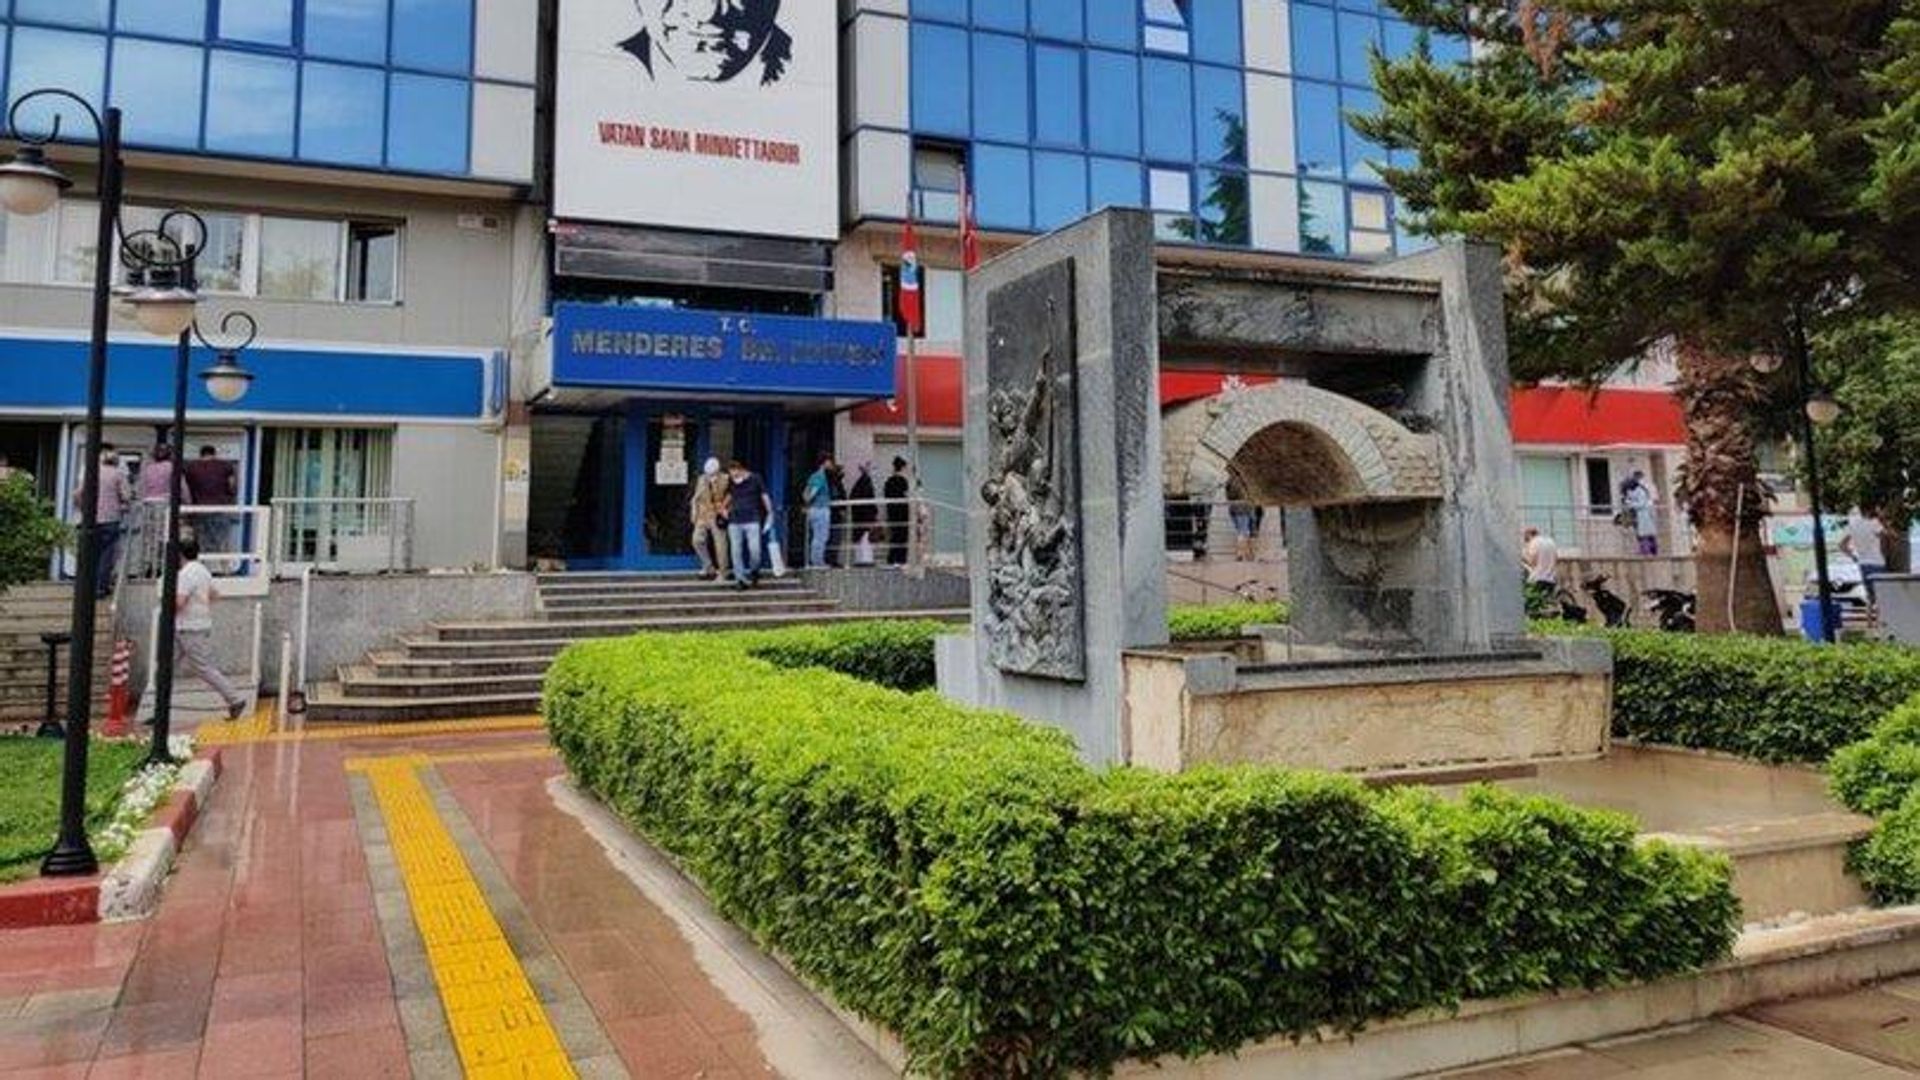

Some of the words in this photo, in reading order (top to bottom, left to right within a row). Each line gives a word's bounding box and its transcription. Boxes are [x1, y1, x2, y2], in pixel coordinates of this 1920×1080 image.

[598, 121, 645, 147] VATAN
[650, 127, 690, 153] SANA
[572, 330, 723, 359] MENDERES
